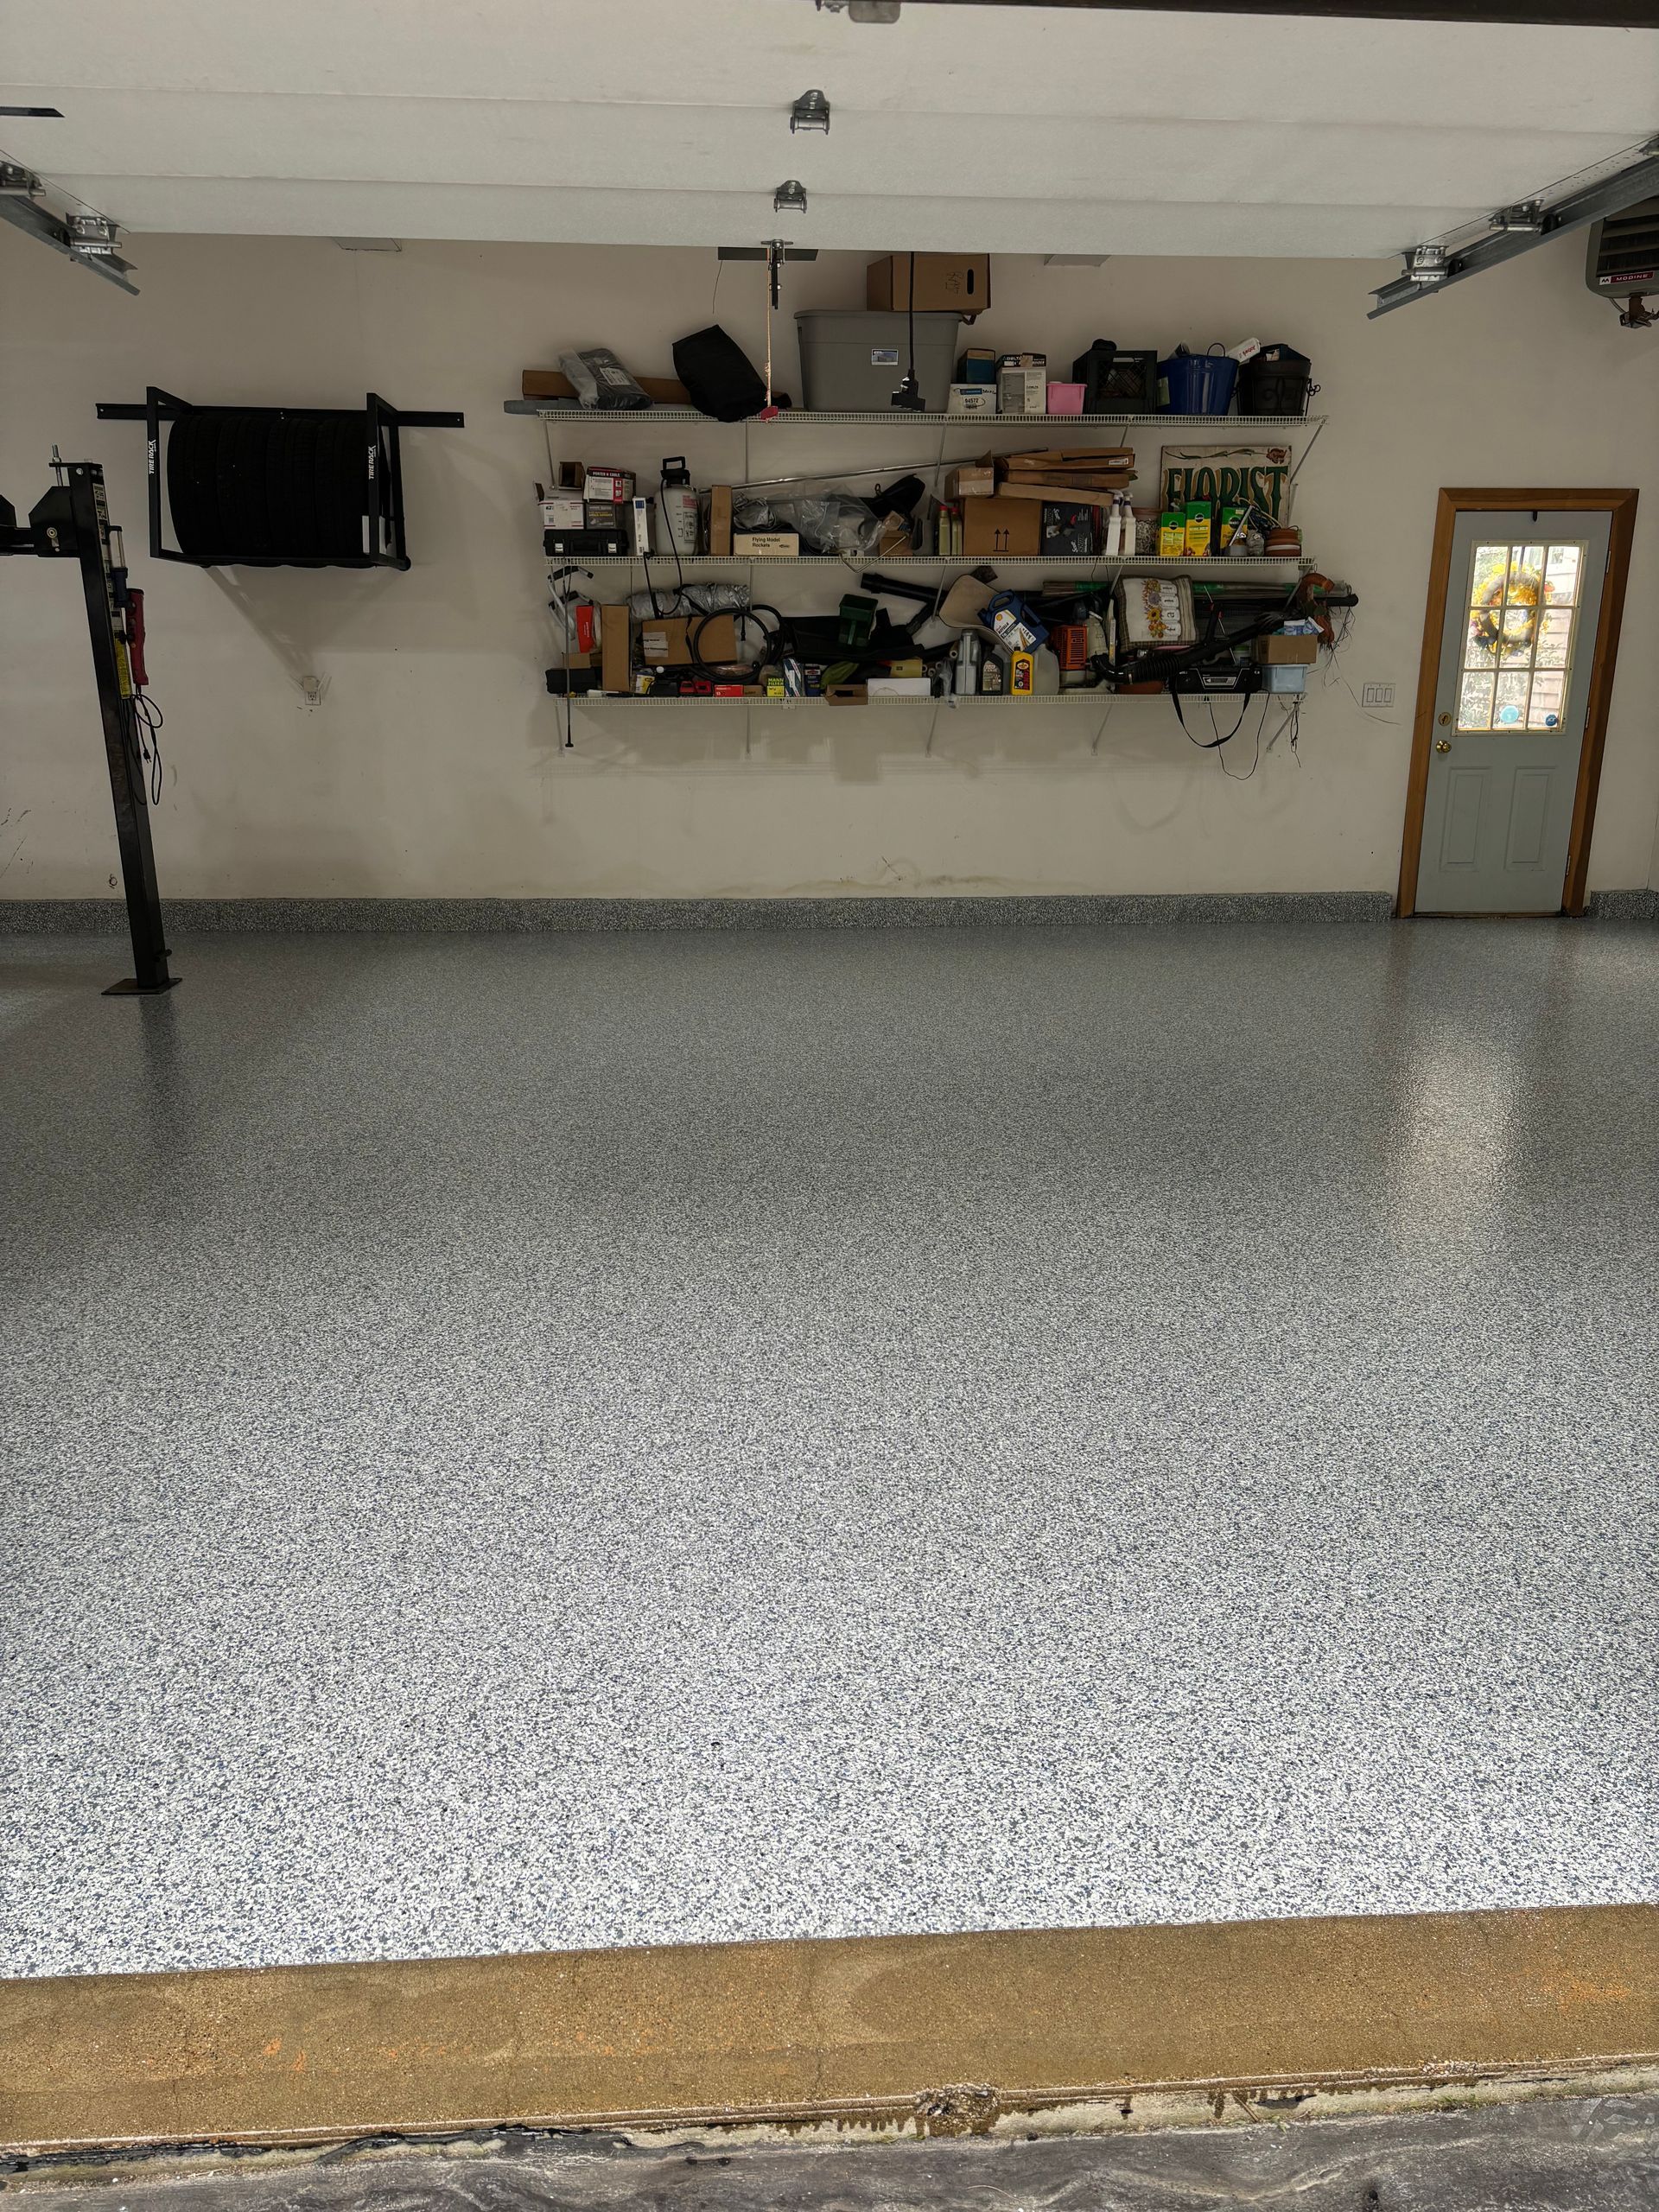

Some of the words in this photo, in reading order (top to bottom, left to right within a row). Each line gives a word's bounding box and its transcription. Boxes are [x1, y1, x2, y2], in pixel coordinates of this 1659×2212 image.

[1616, 273, 1648, 282] MODINE
[148, 439, 156, 459] RACK
[368, 445, 377, 465] RACK
